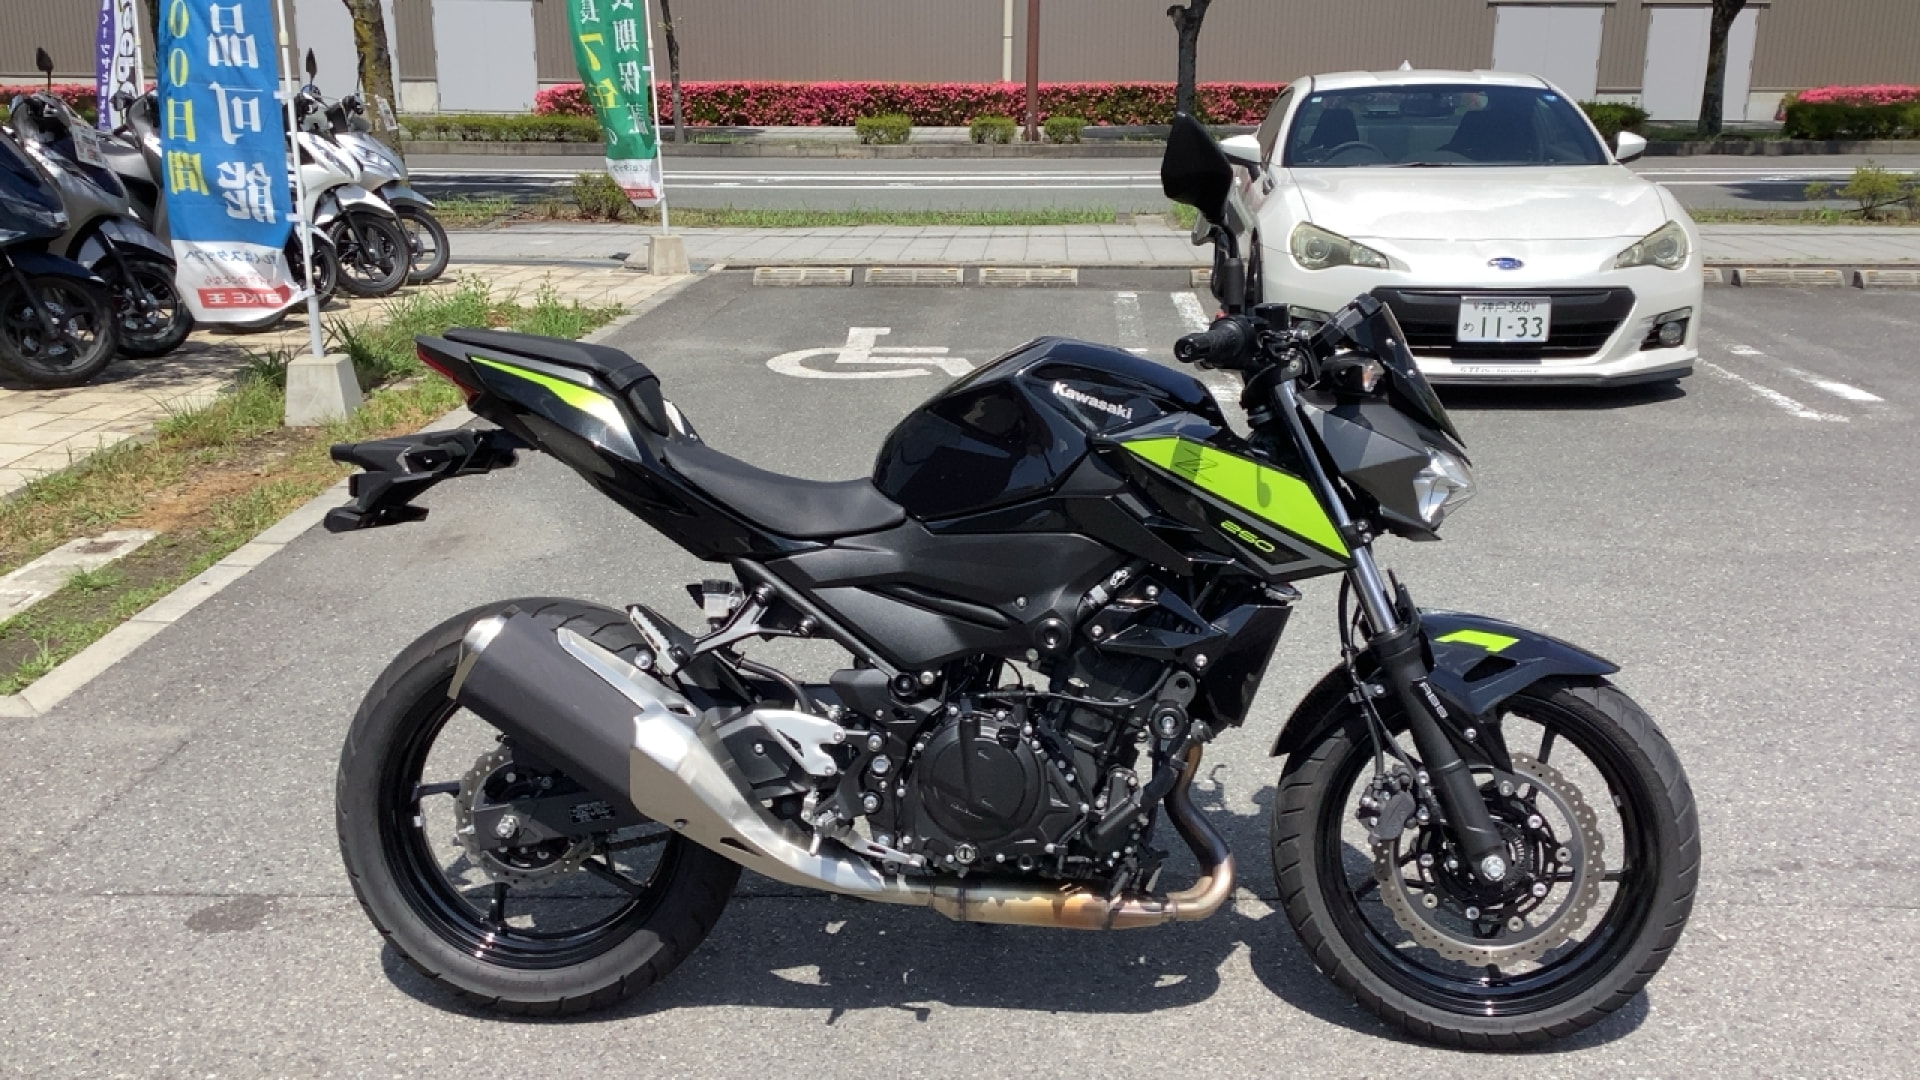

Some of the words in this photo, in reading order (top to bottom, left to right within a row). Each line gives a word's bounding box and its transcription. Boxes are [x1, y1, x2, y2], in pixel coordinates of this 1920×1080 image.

[1481, 316, 1543, 338] 11-33
[1052, 381, 1133, 420] Kawasaki
[1221, 519, 1276, 553] 250
